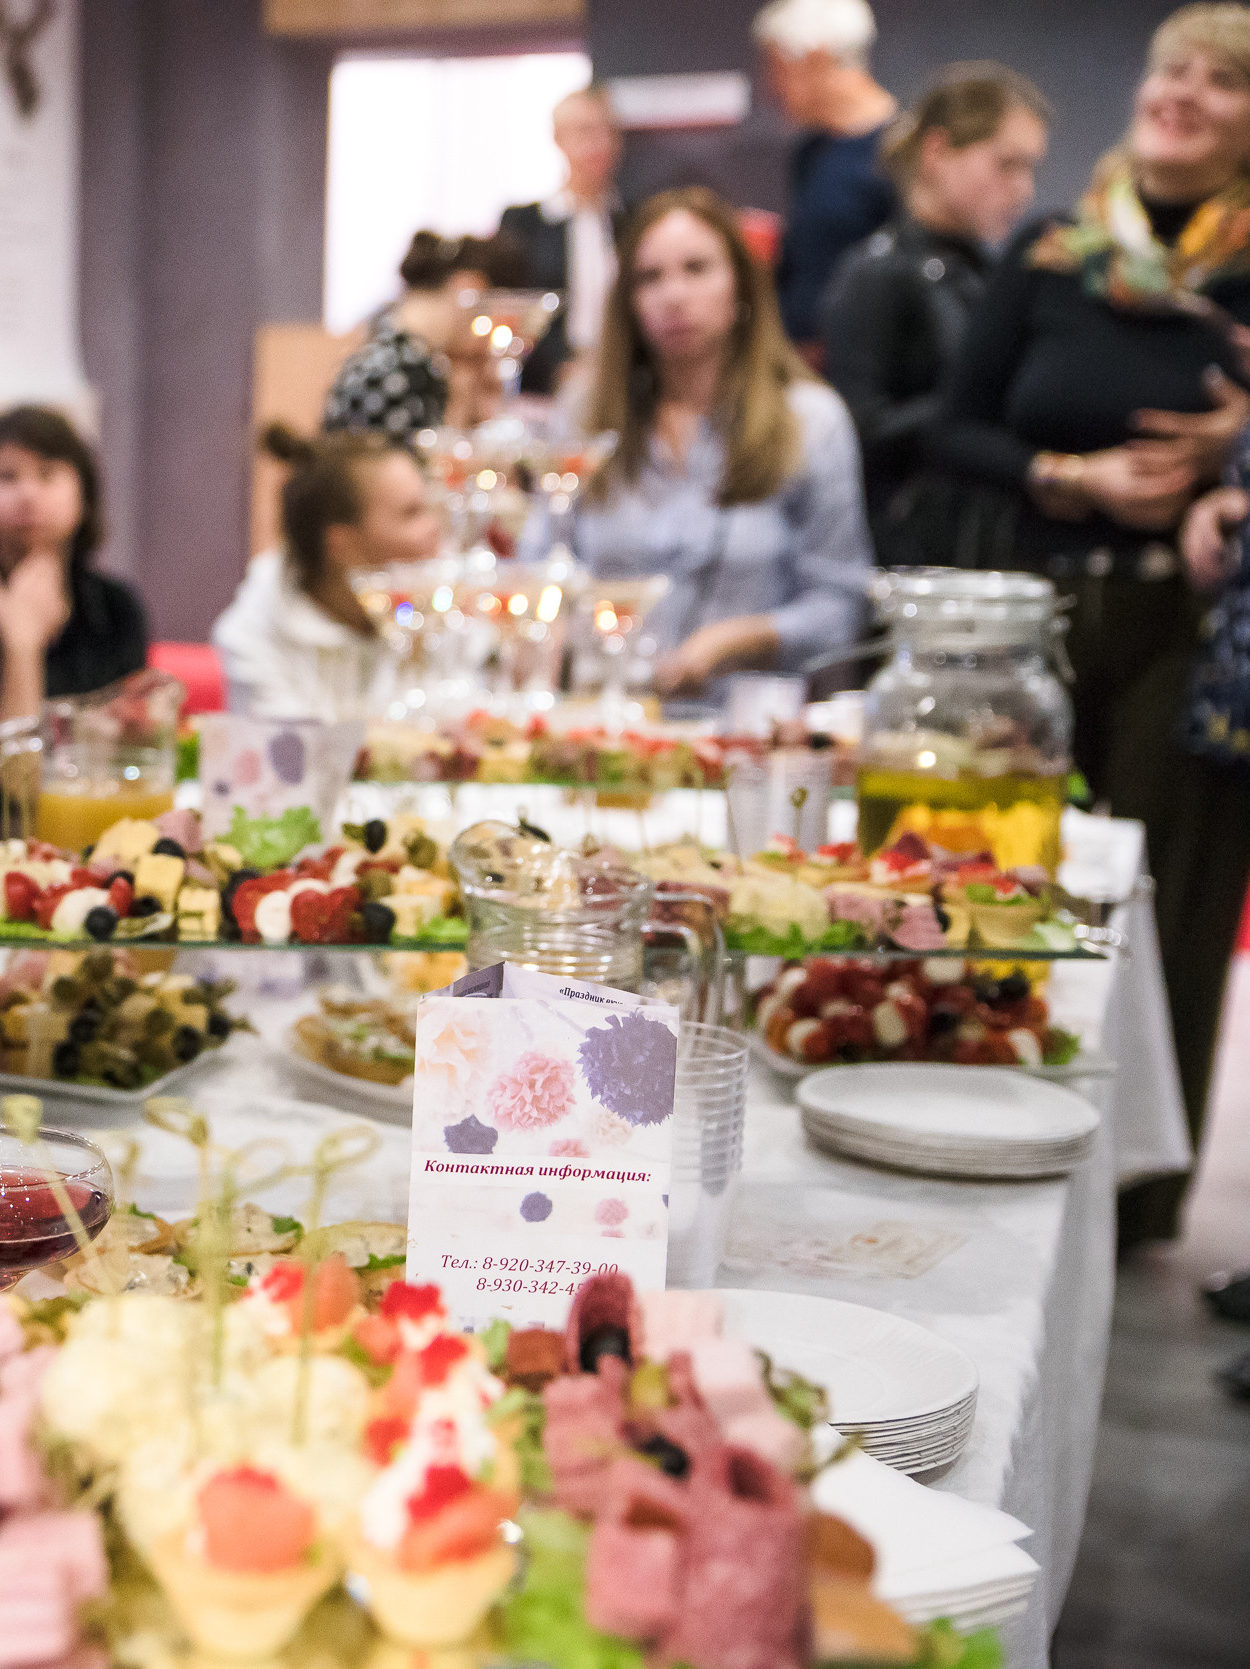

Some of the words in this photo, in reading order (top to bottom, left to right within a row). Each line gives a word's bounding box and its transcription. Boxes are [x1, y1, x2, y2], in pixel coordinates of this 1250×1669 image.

[559, 987, 605, 1004] «Праздник
[424, 1159, 534, 1176] Контактная
[538, 1164, 652, 1183] информация:
[441, 1254, 478, 1269] Тел.:
[482, 1256, 619, 1276] 8-920-347-39-00
